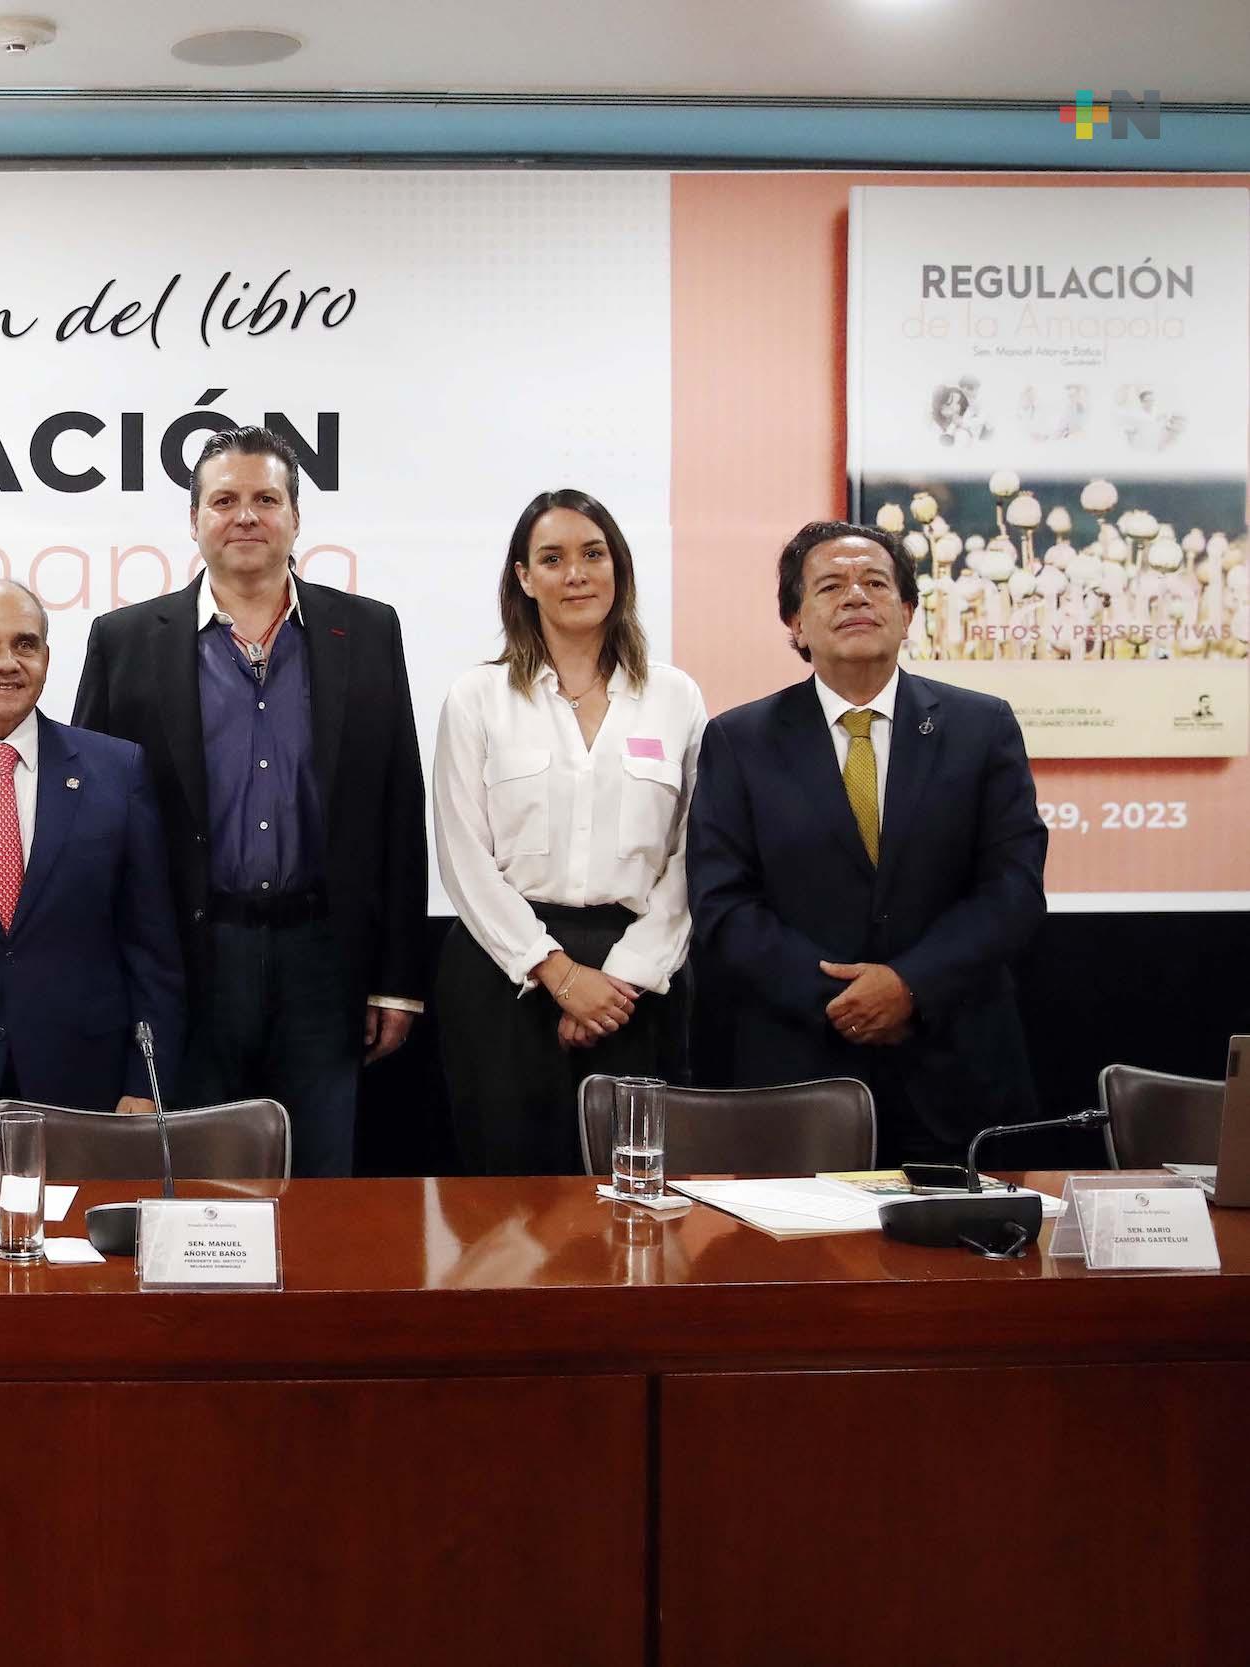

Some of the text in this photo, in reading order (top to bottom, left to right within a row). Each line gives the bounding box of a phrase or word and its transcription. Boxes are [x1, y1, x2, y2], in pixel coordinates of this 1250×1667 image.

[923, 257, 1193, 299] REGULACIÓN
[55, 273, 181, 349] del
[200, 269, 357, 347] libro
[901, 301, 1185, 361] de la Amapola
[972, 623, 1232, 641] RETOS Y PERSPECTIVAS
[1038, 801, 1188, 834] 29, 2023
[184, 1249, 247, 1257] AÑORVE BAÑOS
